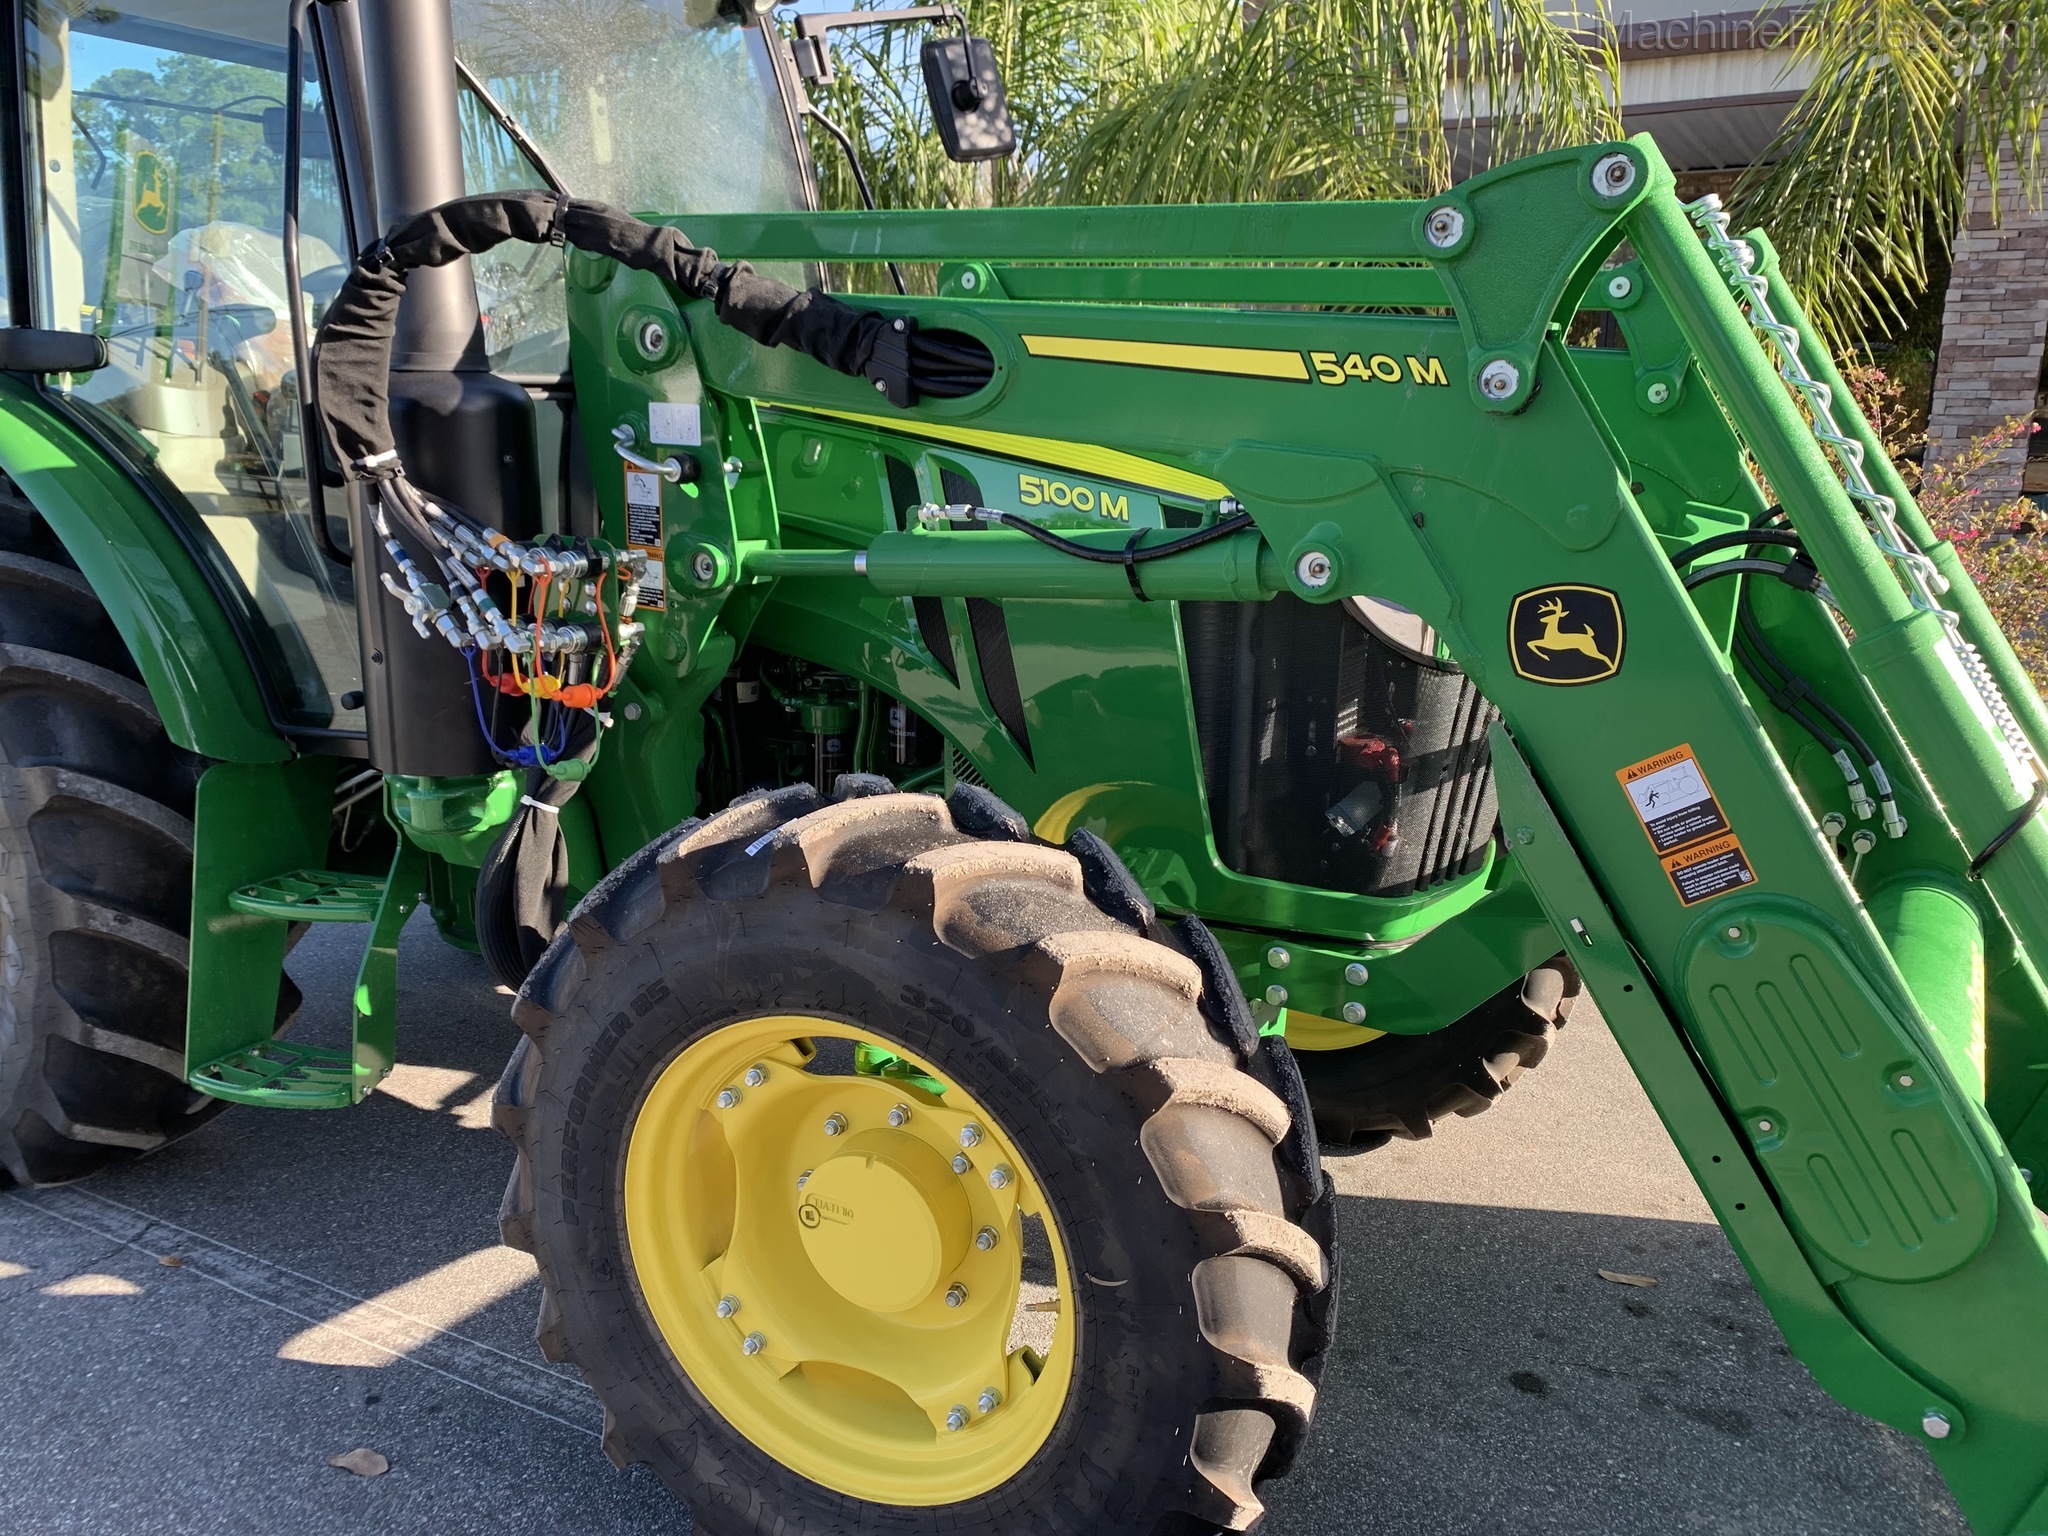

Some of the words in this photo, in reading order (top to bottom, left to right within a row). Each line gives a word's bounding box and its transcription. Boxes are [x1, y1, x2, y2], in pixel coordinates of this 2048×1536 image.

[1308, 350, 1404, 386] 540
[1404, 354, 1450, 387] M
[1018, 473, 1095, 512] 5100
[1099, 491, 1129, 522] M
[1637, 751, 1684, 774] WARNING
[1683, 841, 1731, 863] WARNING
[900, 984, 1096, 1173] 320/85R24
[561, 1010, 634, 1226] PERFORMER
[630, 977, 672, 1018] 85
